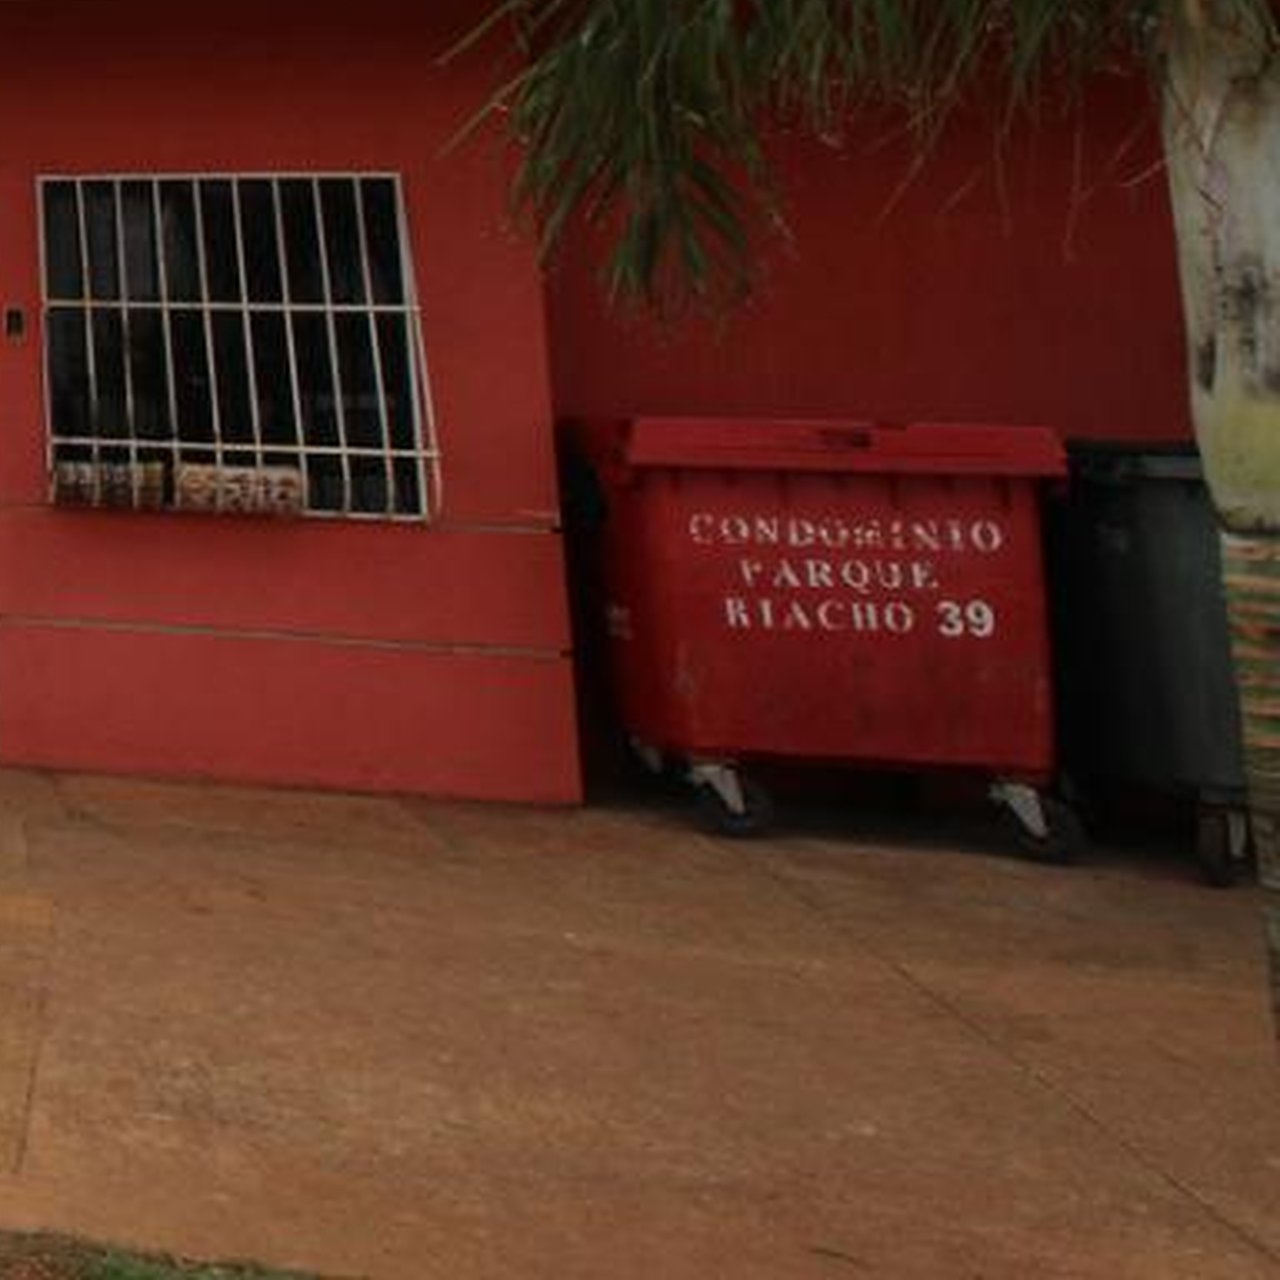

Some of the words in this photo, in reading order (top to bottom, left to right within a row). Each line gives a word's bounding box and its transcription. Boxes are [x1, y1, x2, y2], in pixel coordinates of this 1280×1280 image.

[740, 559, 939, 594] PARQUE
[725, 598, 915, 633] RIACHO
[937, 600, 996, 637] 39
